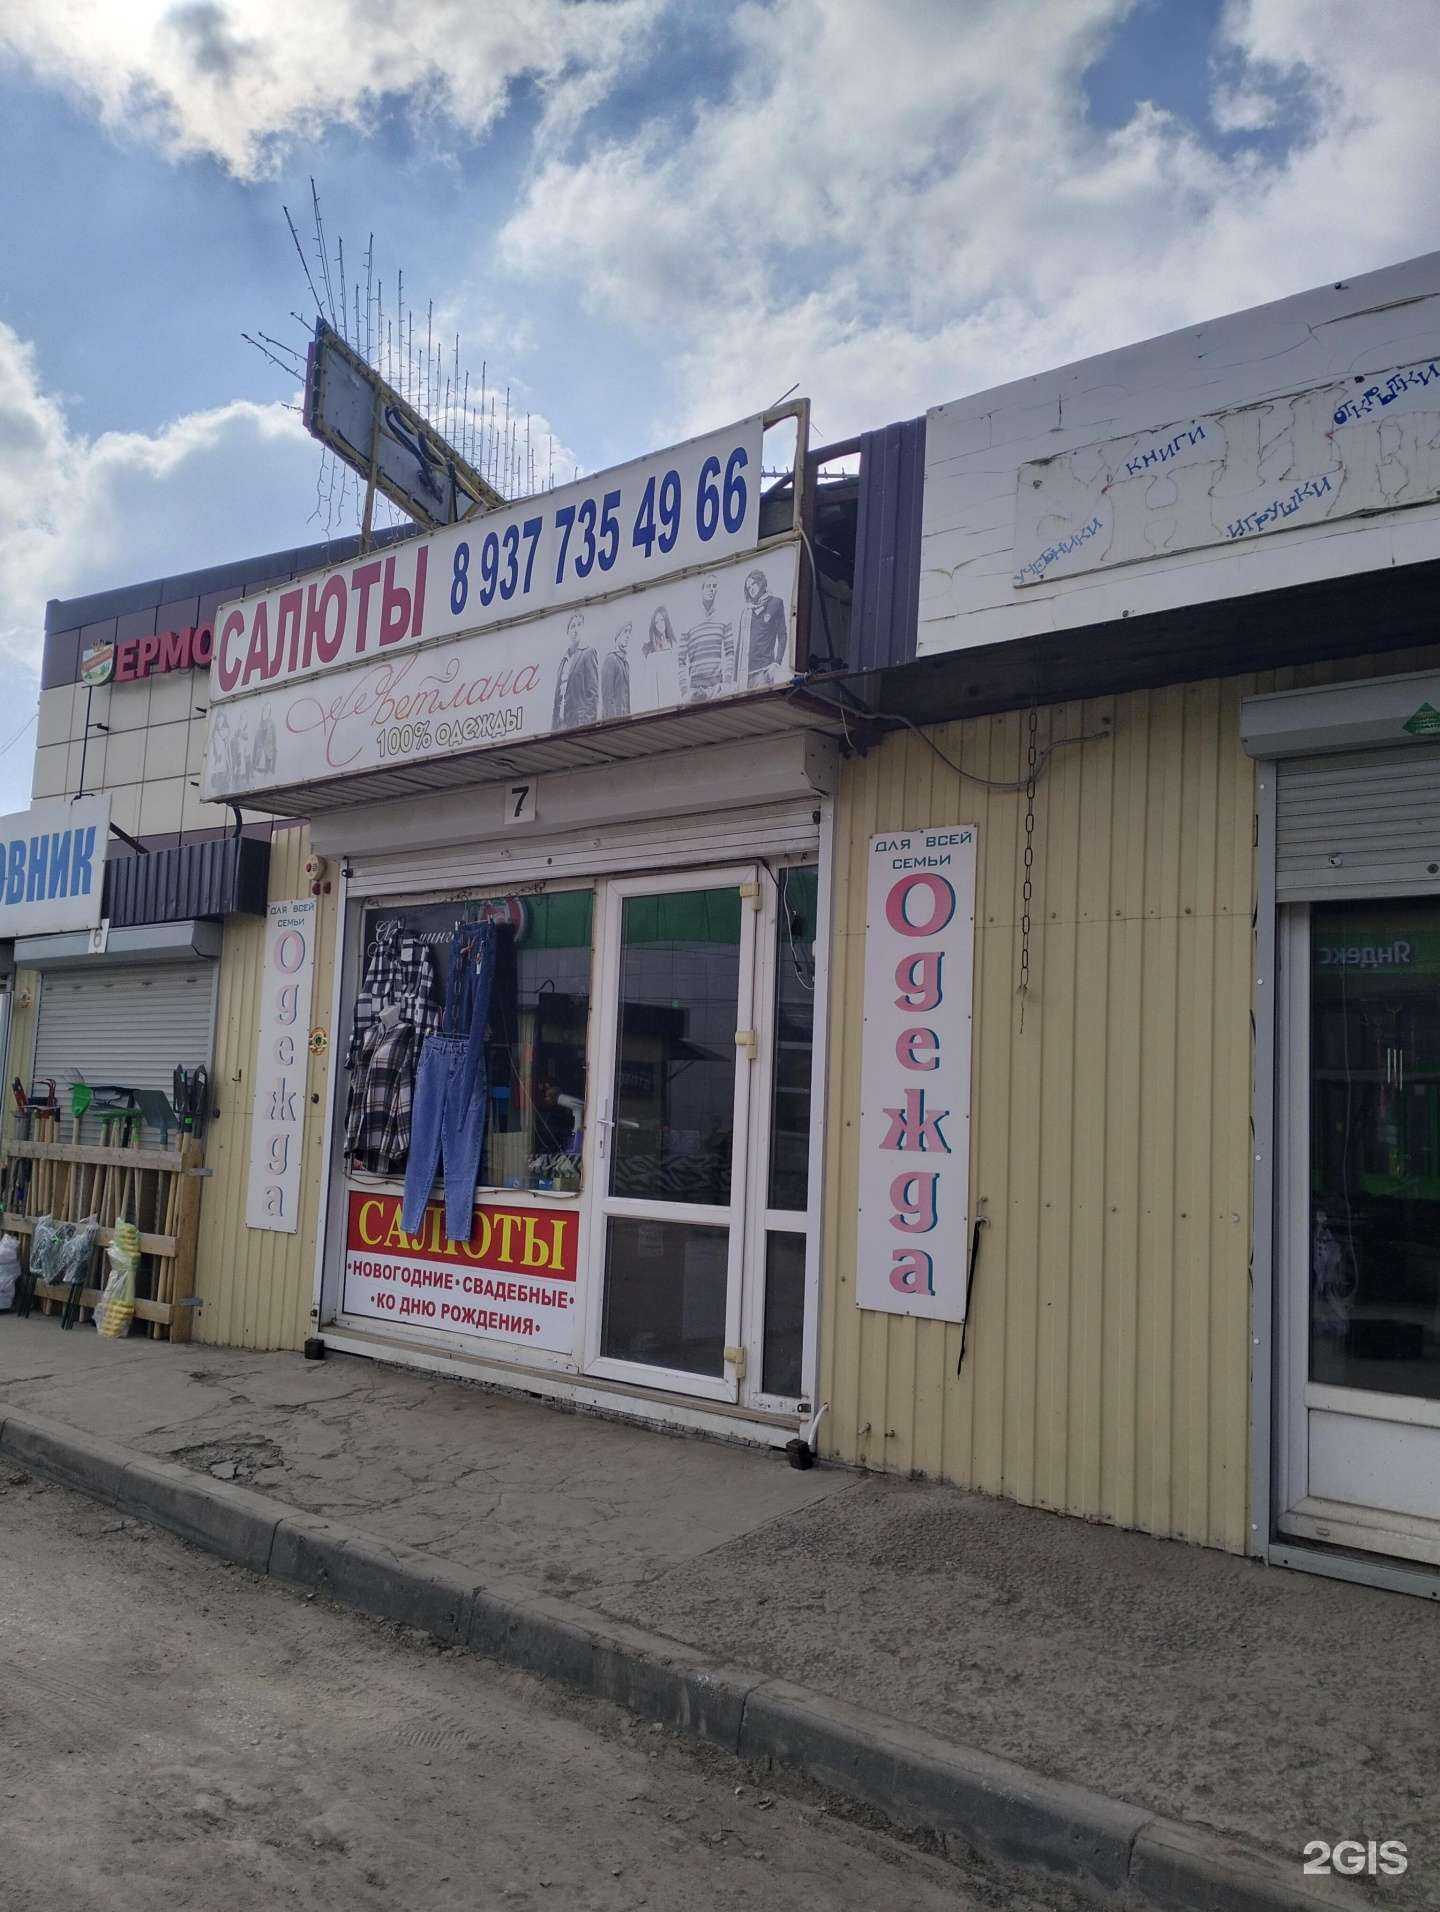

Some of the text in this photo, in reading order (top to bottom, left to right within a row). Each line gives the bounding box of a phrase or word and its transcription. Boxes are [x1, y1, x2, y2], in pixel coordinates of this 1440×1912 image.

[1333, 363, 1440, 424] ОТКРЫТКИ
[1125, 425, 1206, 476] КНИГИ
[1228, 475, 1332, 539] ИГРУШКИ
[218, 446, 749, 693] САЛЮТЫ 8 937 735 49 66
[1013, 516, 1104, 585] УЧЕБНИКИ
[376, 719, 433, 758] 100%
[511, 785, 530, 818] 7
[875, 830, 972, 853] ДЛЯ ВСЕЙ
[892, 853, 952, 870] СЕМЬИ
[277, 918, 305, 928] СЕМЬИ
[293, 902, 315, 913] ВСЕЙ
[263, 929, 306, 1218] Одежда
[879, 872, 956, 1297] Одежда
[353, 1260, 569, 1309] НОВОГОДНИЕ СВАДЕБНЫЕ
[376, 1292, 535, 1335] КО ДНЮ РОЖДЕНИЯ
